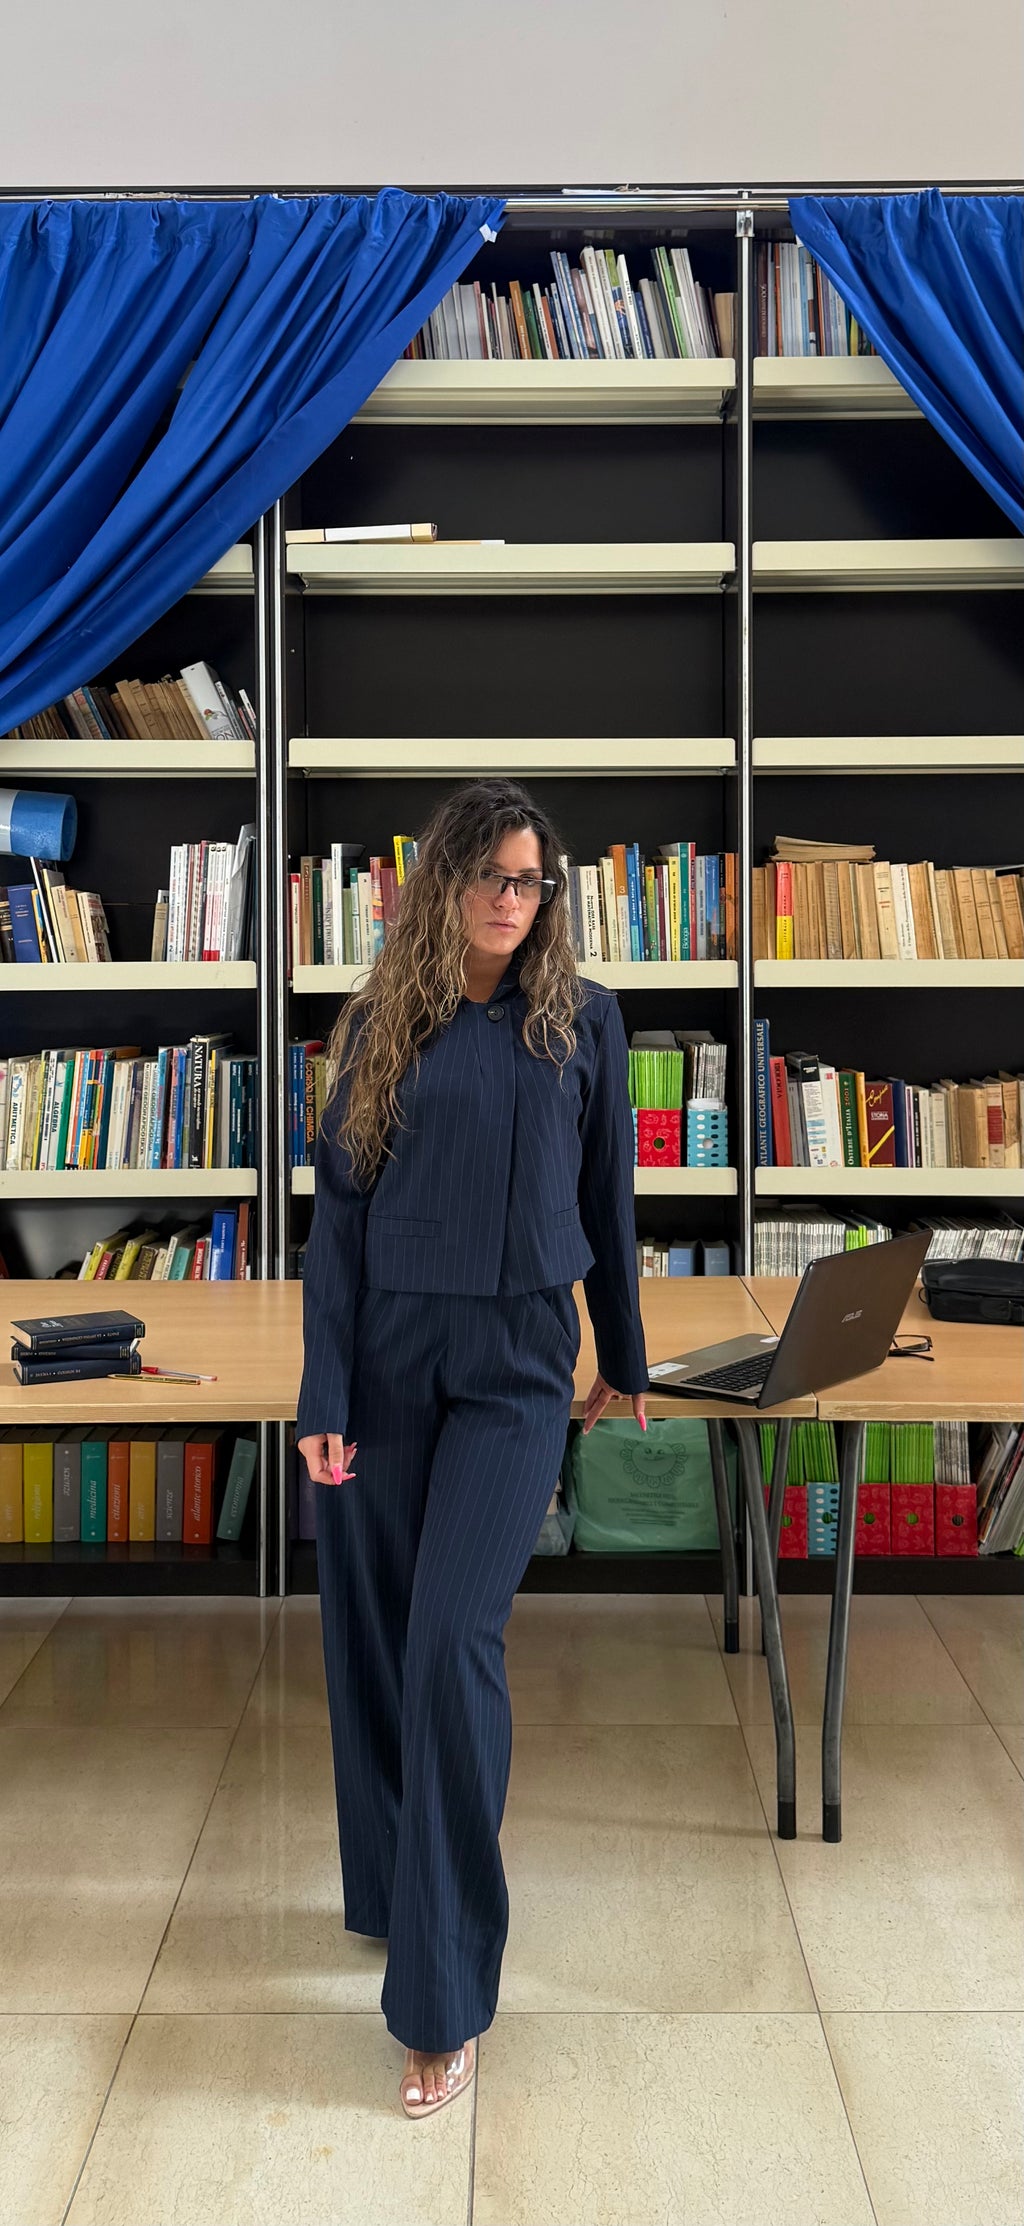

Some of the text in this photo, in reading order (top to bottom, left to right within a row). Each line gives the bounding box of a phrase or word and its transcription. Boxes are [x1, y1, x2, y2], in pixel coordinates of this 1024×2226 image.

[193, 1044, 203, 1087] NATURA
[305, 1062, 314, 1093] CORSO
[756, 1022, 768, 1166] ATLANTE GEOGRAFICO UNIVERSALE
[9, 1102, 18, 1145] ARITMETICA
[51, 1101, 60, 1133] ALGEBRA
[305, 1106, 314, 1143] CHIMICA
[841, 1309, 863, 1323] ASUS
[63, 1466, 71, 1496] scienze
[87, 1480, 97, 1519] medicina
[191, 1466, 201, 1521] atlante storico
[230, 1476, 244, 1518] economia
[112, 1483, 121, 1520] citazioni
[164, 1489, 173, 1519] scienze
